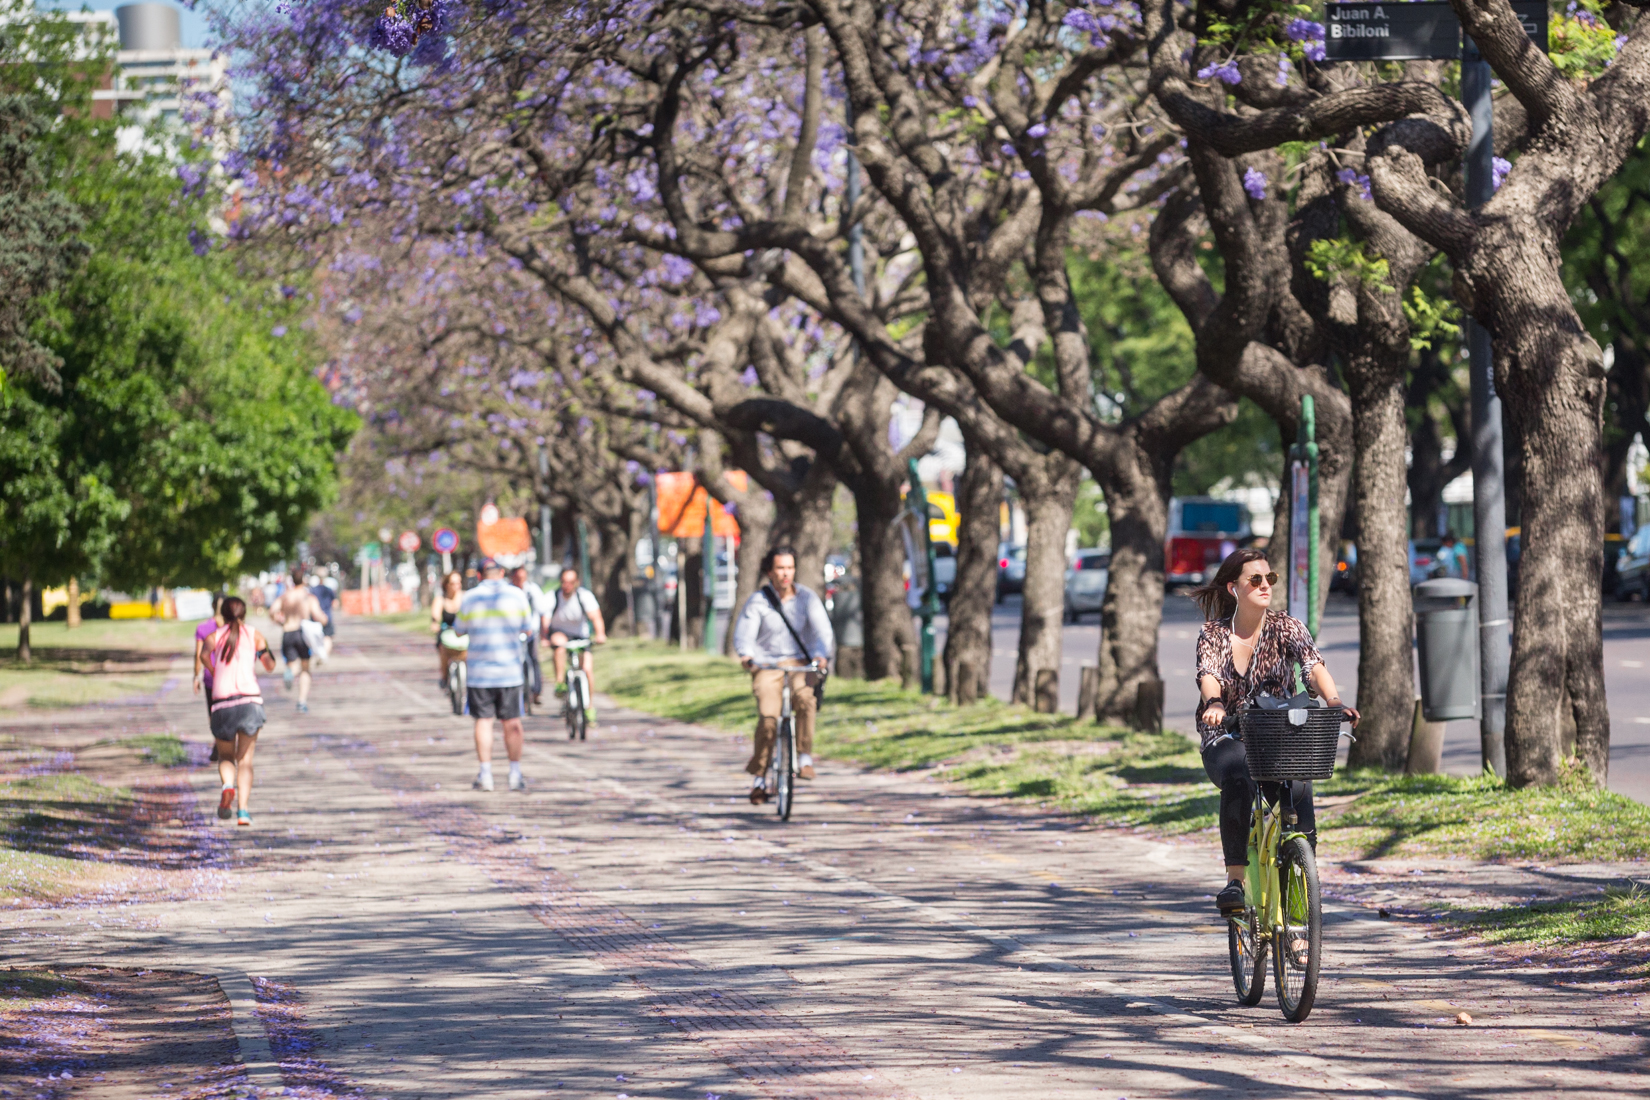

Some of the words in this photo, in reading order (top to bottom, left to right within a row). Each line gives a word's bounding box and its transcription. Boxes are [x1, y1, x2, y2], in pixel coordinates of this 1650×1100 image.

[1331, 6, 1370, 20] Juan
[1373, 5, 1390, 20] A.
[1331, 23, 1390, 38] Bibiloni
